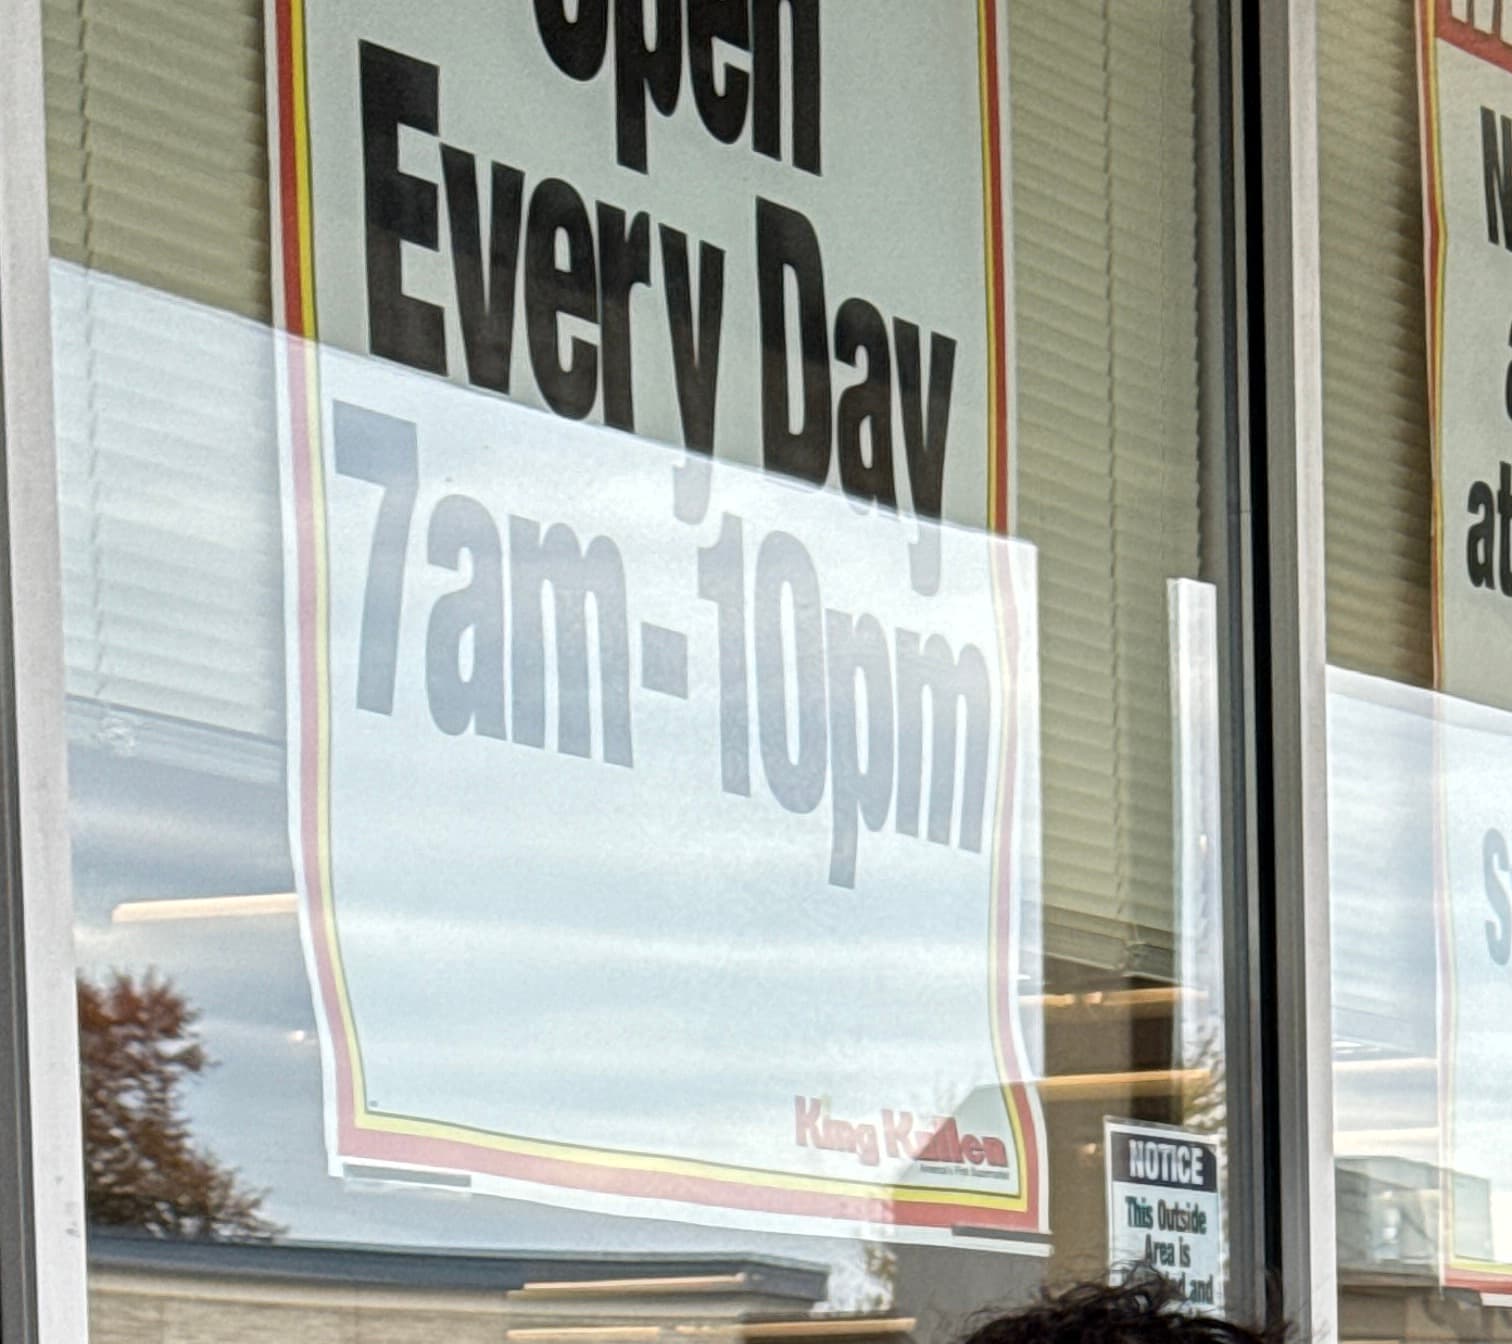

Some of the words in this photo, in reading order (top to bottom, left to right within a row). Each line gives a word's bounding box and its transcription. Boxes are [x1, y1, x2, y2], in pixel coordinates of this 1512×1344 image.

[533, 0, 821, 176] pen
[360, 39, 724, 525] Every
[756, 197, 956, 596] Day
[332, 400, 990, 889] 7am-10pm
[794, 1094, 880, 1167] King
[1129, 1139, 1204, 1185] NOTICE
[1126, 1195, 1154, 1229] This
[1157, 1199, 1207, 1235] Outside
[1145, 1234, 1175, 1267] Area
[1179, 1236, 1191, 1268] is
[1189, 1273, 1214, 1305] and
